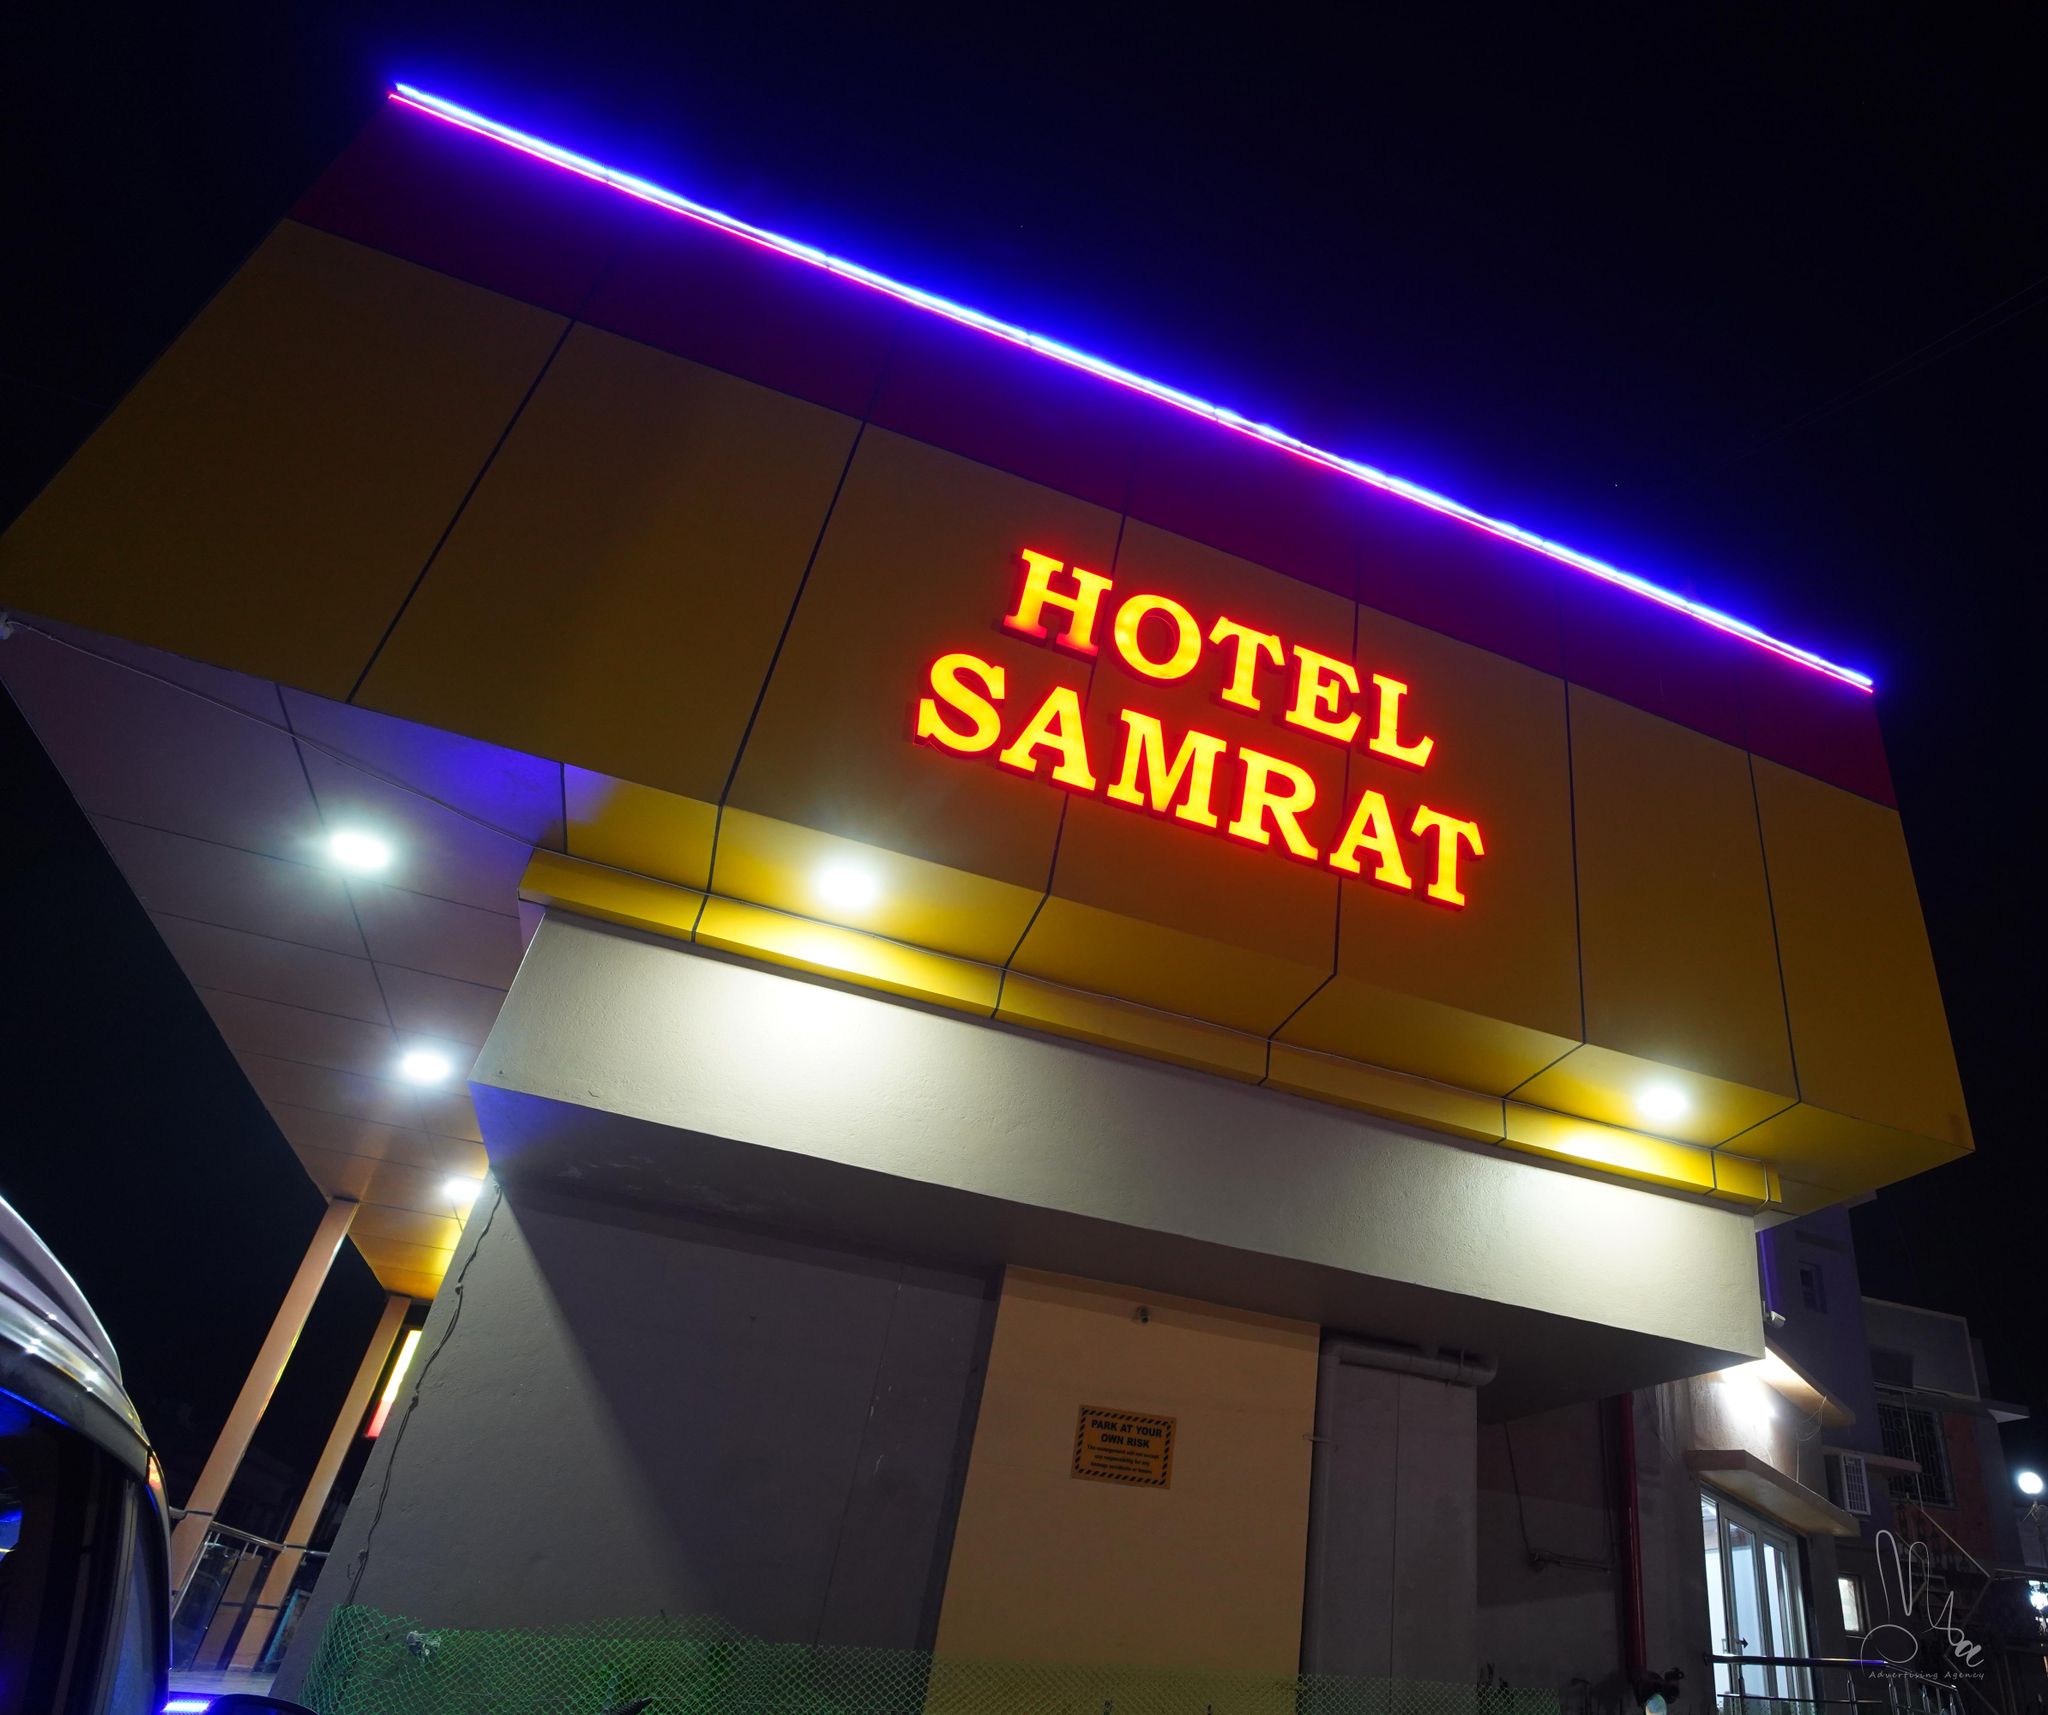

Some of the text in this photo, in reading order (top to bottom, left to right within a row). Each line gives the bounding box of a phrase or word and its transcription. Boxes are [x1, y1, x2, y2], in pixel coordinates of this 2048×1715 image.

[1001, 547, 1436, 770] HOTEL
[915, 652, 1486, 907] SAMRAT
[1091, 1419, 1162, 1438] PARK AT YOUR
[1101, 1433, 1150, 1448] OWN RISK
